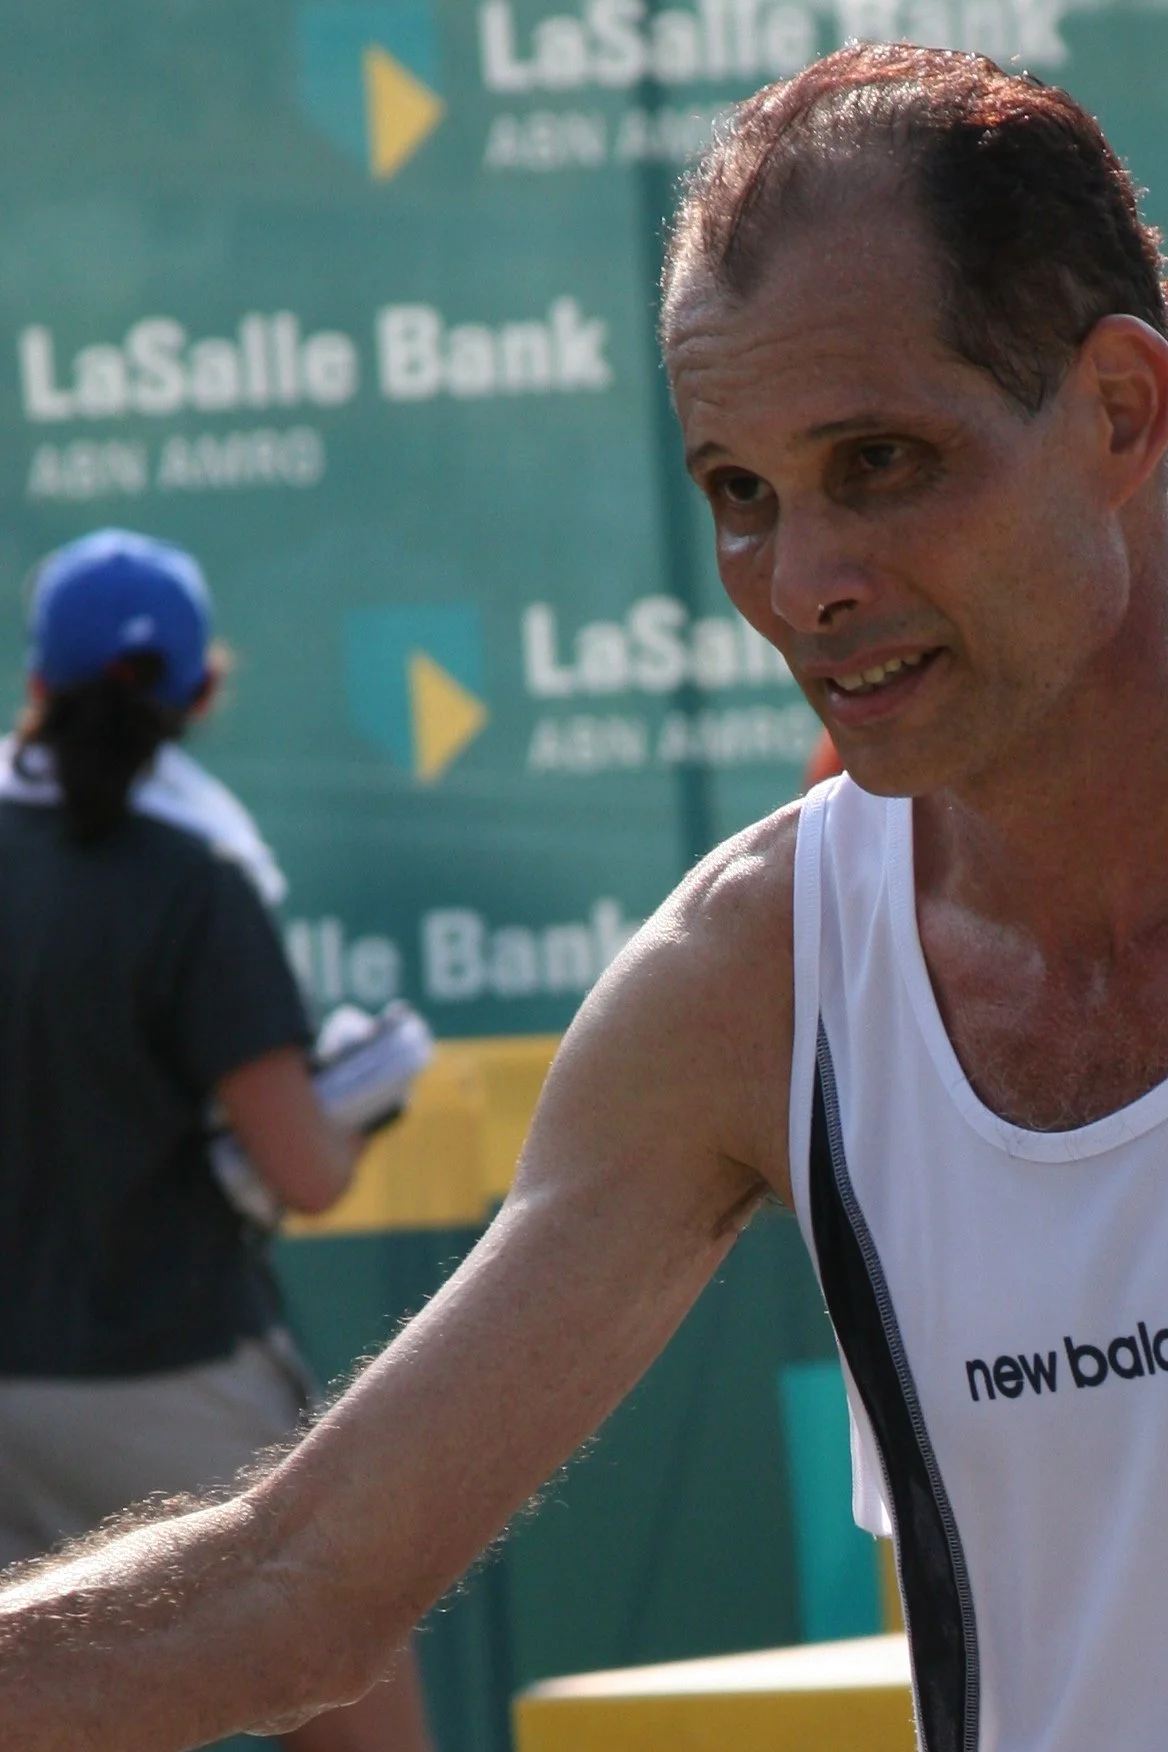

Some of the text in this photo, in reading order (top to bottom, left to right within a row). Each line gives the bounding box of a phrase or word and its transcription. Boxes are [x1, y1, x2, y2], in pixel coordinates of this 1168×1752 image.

[480, 0, 817, 92] LaSalle
[20, 296, 613, 419] LaSalle Bank
[965, 1350, 1058, 1402] new
